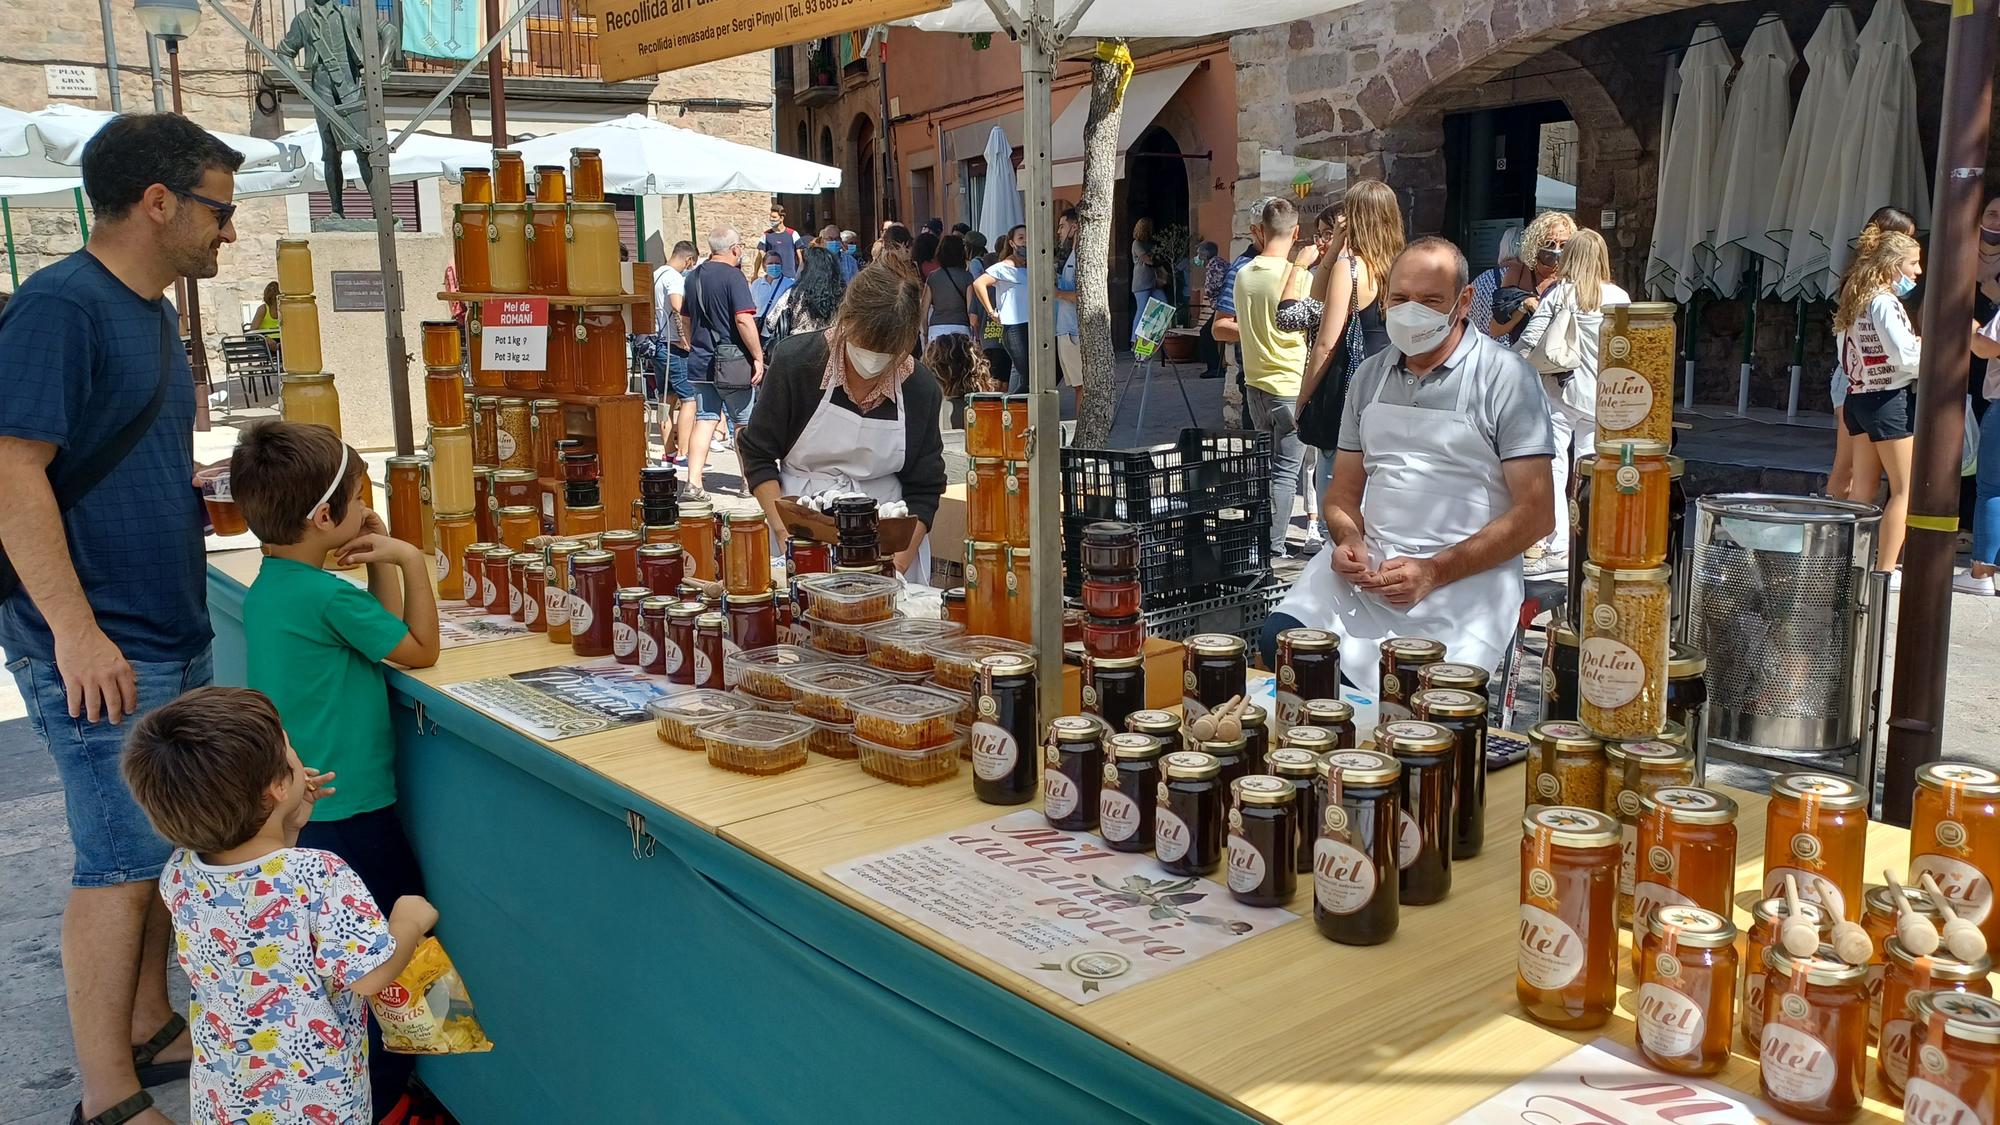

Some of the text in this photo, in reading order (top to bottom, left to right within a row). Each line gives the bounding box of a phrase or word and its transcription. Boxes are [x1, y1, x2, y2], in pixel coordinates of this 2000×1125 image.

[606, 0, 668, 32] Recollida
[638, 36, 673, 56] Recollida
[673, 34, 677, 46] i
[677, 26, 715, 46] envasada
[716, 24, 731, 40] per
[732, 13, 756, 33] Sergi
[756, 7, 783, 27] Pinyol
[785, 2, 804, 22] (Tel.
[805, 0, 817, 14] 93
[59, 69, 86, 77] PLAÇA
[504, 302, 530, 312] Mel de
[501, 312, 533, 324] ROMANÍ
[495, 336, 506, 345] Pot
[513, 336, 521, 346] kg
[1862, 345, 1884, 354] MOSCO
[495, 353, 531, 363] Pot 3 kg 22
[1867, 366, 1895, 376] HELSINKI
[974, 733, 1007, 756] Mel
[991, 824, 1115, 865] Mel
[1316, 852, 1364, 883] Mel
[1035, 897, 1186, 962] roure
[1520, 918, 1570, 959] Mel
[381, 986, 401, 998] RIT
[375, 1003, 424, 1023] Caseras
[1639, 996, 1693, 1030] Mel
[1765, 1036, 1822, 1073] Mel
